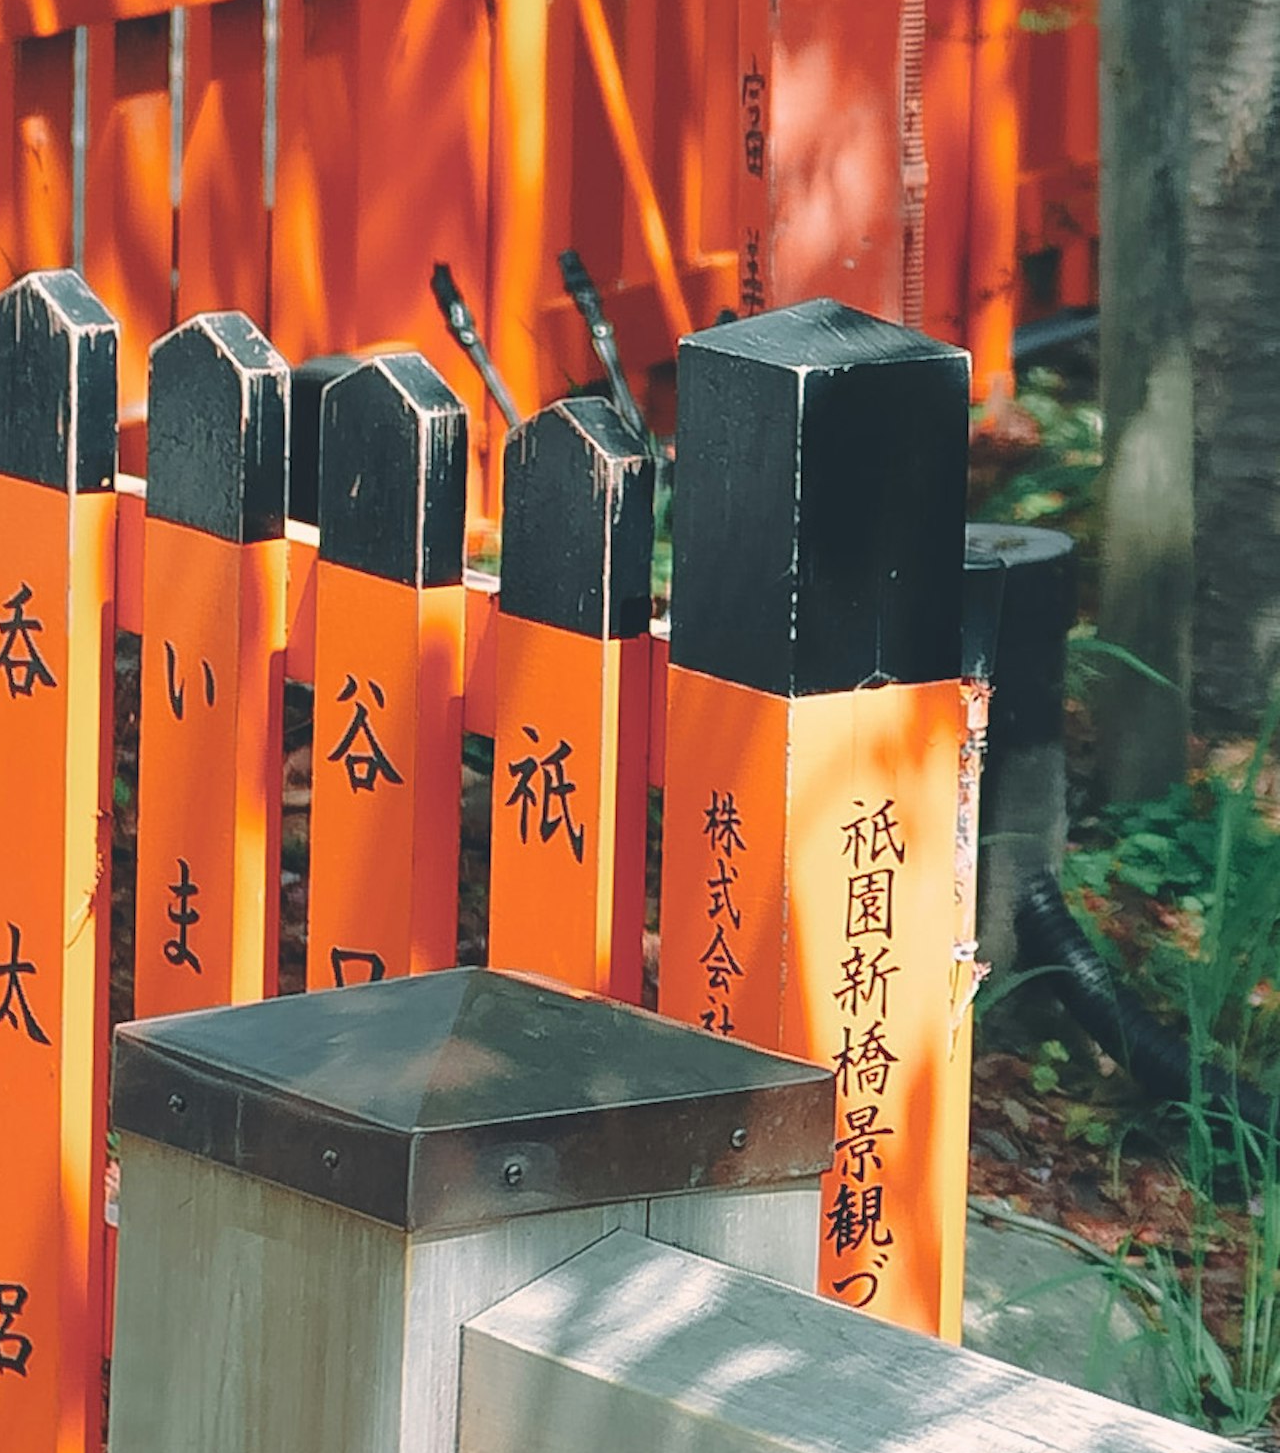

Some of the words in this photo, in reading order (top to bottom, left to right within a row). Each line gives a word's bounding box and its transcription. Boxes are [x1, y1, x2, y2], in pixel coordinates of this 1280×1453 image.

[163, 640, 216, 973] いま
[505, 726, 585, 864] 祇
[826, 798, 905, 1308] 祇園新橋景観づ
